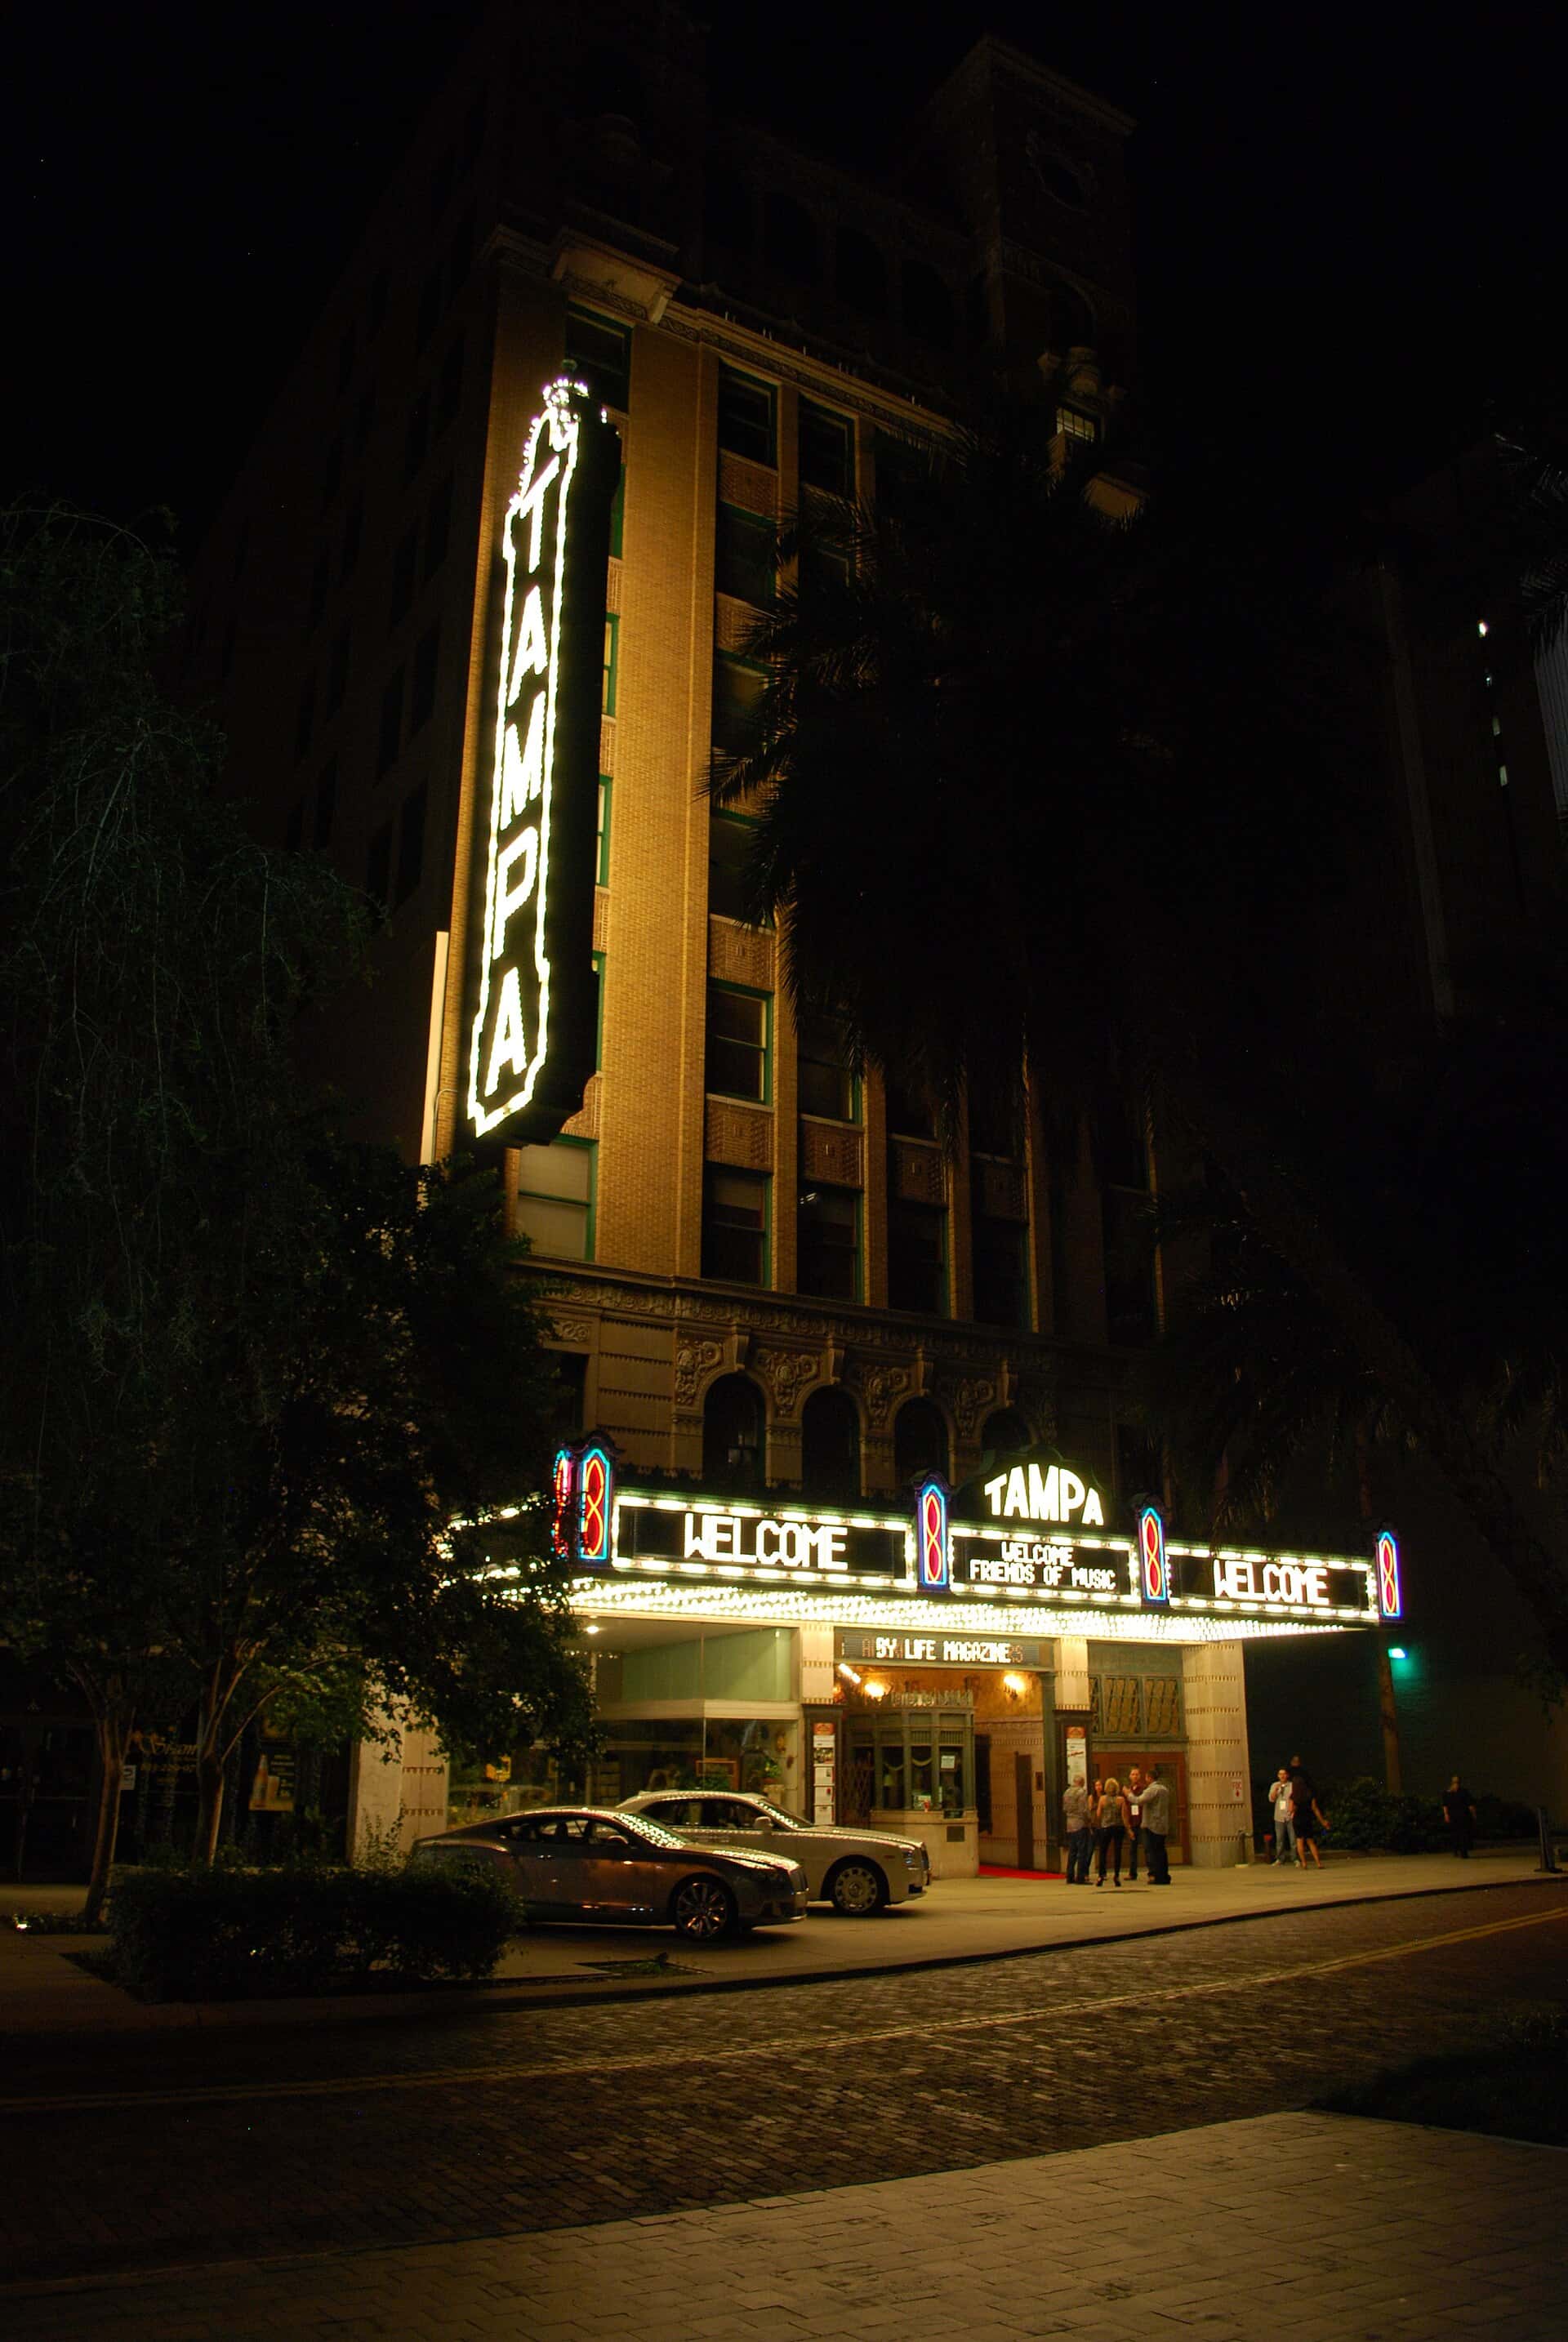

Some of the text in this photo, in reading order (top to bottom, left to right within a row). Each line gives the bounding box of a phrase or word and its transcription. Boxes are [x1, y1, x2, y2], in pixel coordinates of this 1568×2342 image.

[484, 455, 559, 1097] TAMPA
[984, 1463, 1104, 1526] TAMPA
[684, 1512, 849, 1570] WELCOME
[1001, 1541, 1074, 1567] WELCOME
[969, 1559, 1116, 1591] FRIENDS OF MUSIC
[1214, 1559, 1330, 1604] WELCOME
[904, 1638, 936, 1660] LIFE
[942, 1640, 1011, 1663] MAGAZINE
